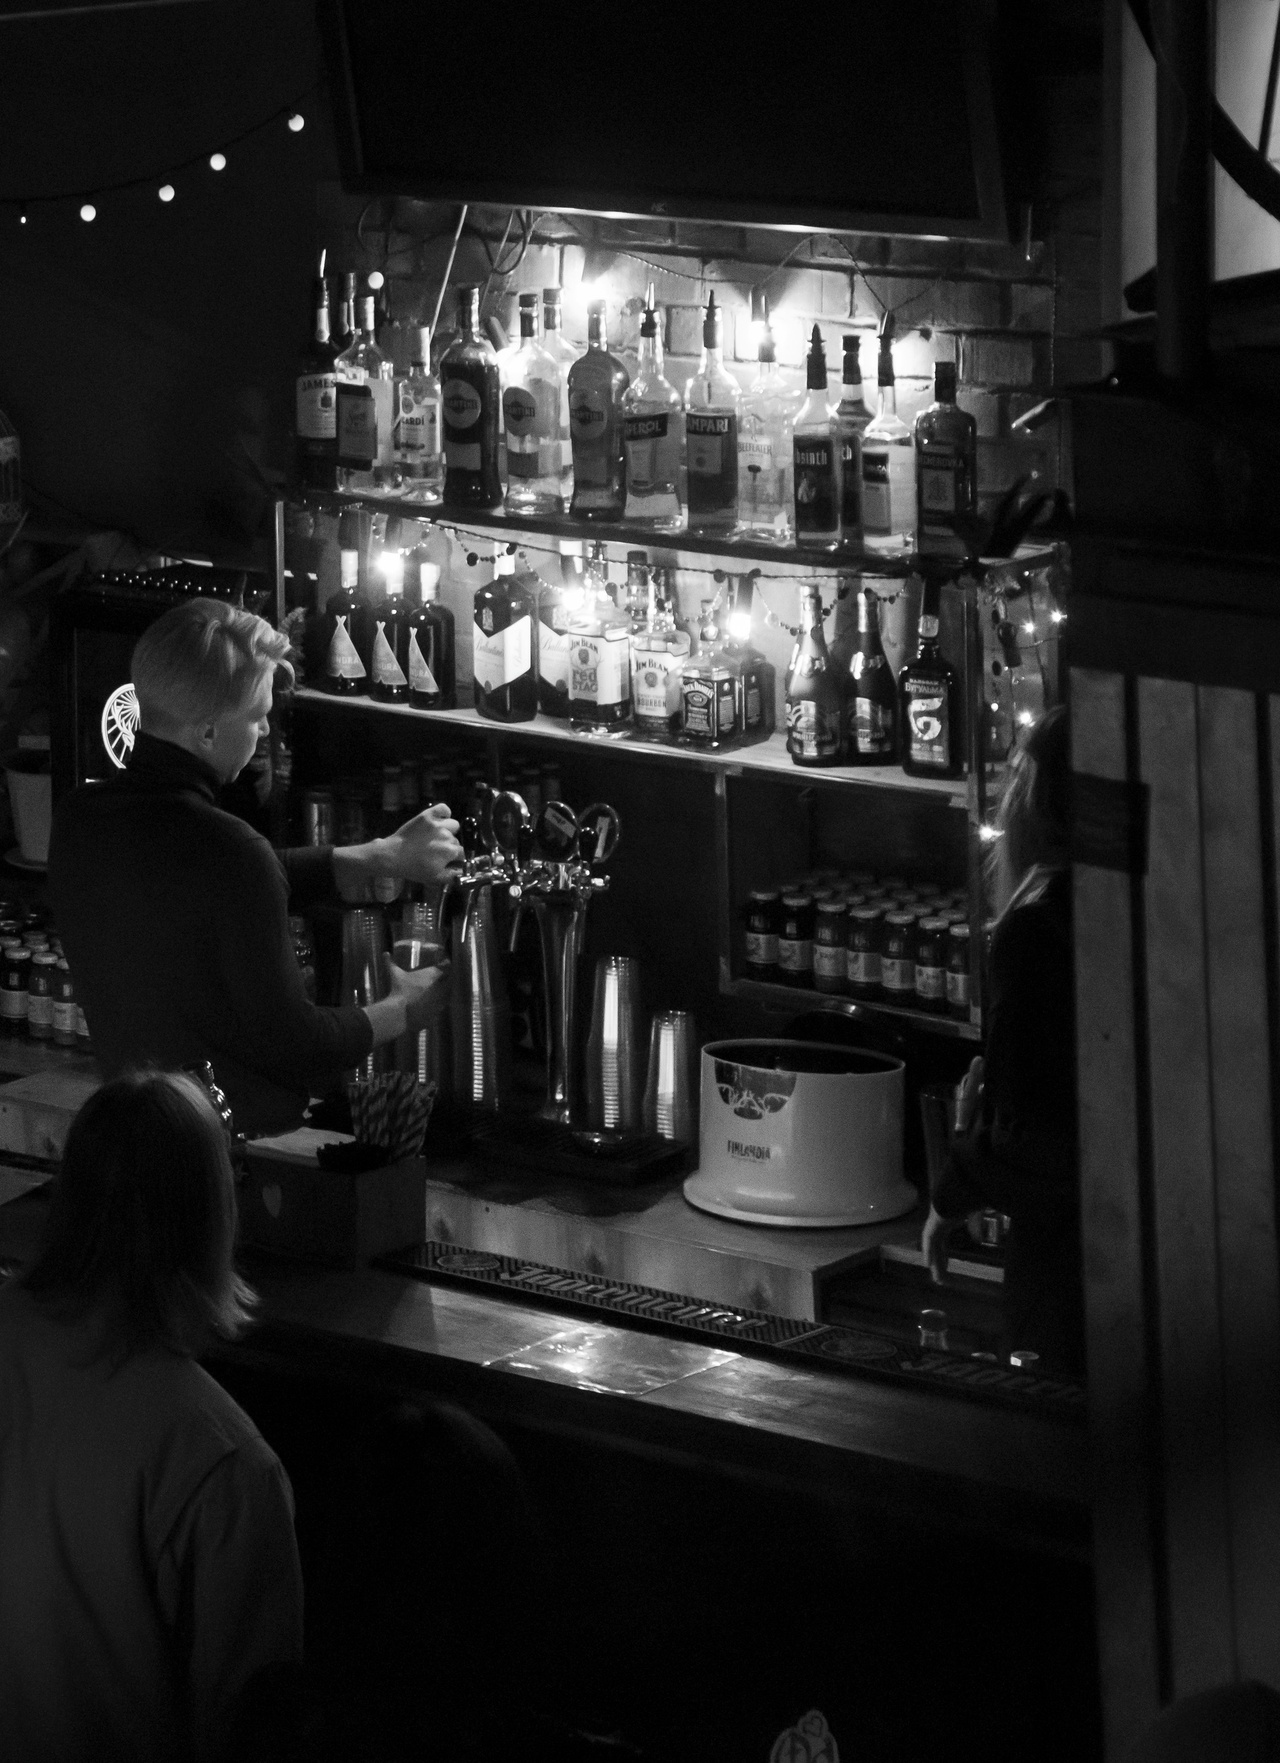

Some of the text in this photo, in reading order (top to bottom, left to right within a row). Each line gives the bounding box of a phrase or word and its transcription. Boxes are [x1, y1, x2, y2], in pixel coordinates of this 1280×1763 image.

[569, 637, 599, 655] JIM BEAM
[572, 667, 598, 683] red
[636, 657, 669, 676] JIM BEAM
[572, 681, 599, 694] STAG
[727, 1139, 772, 1160] FINLANDIA
